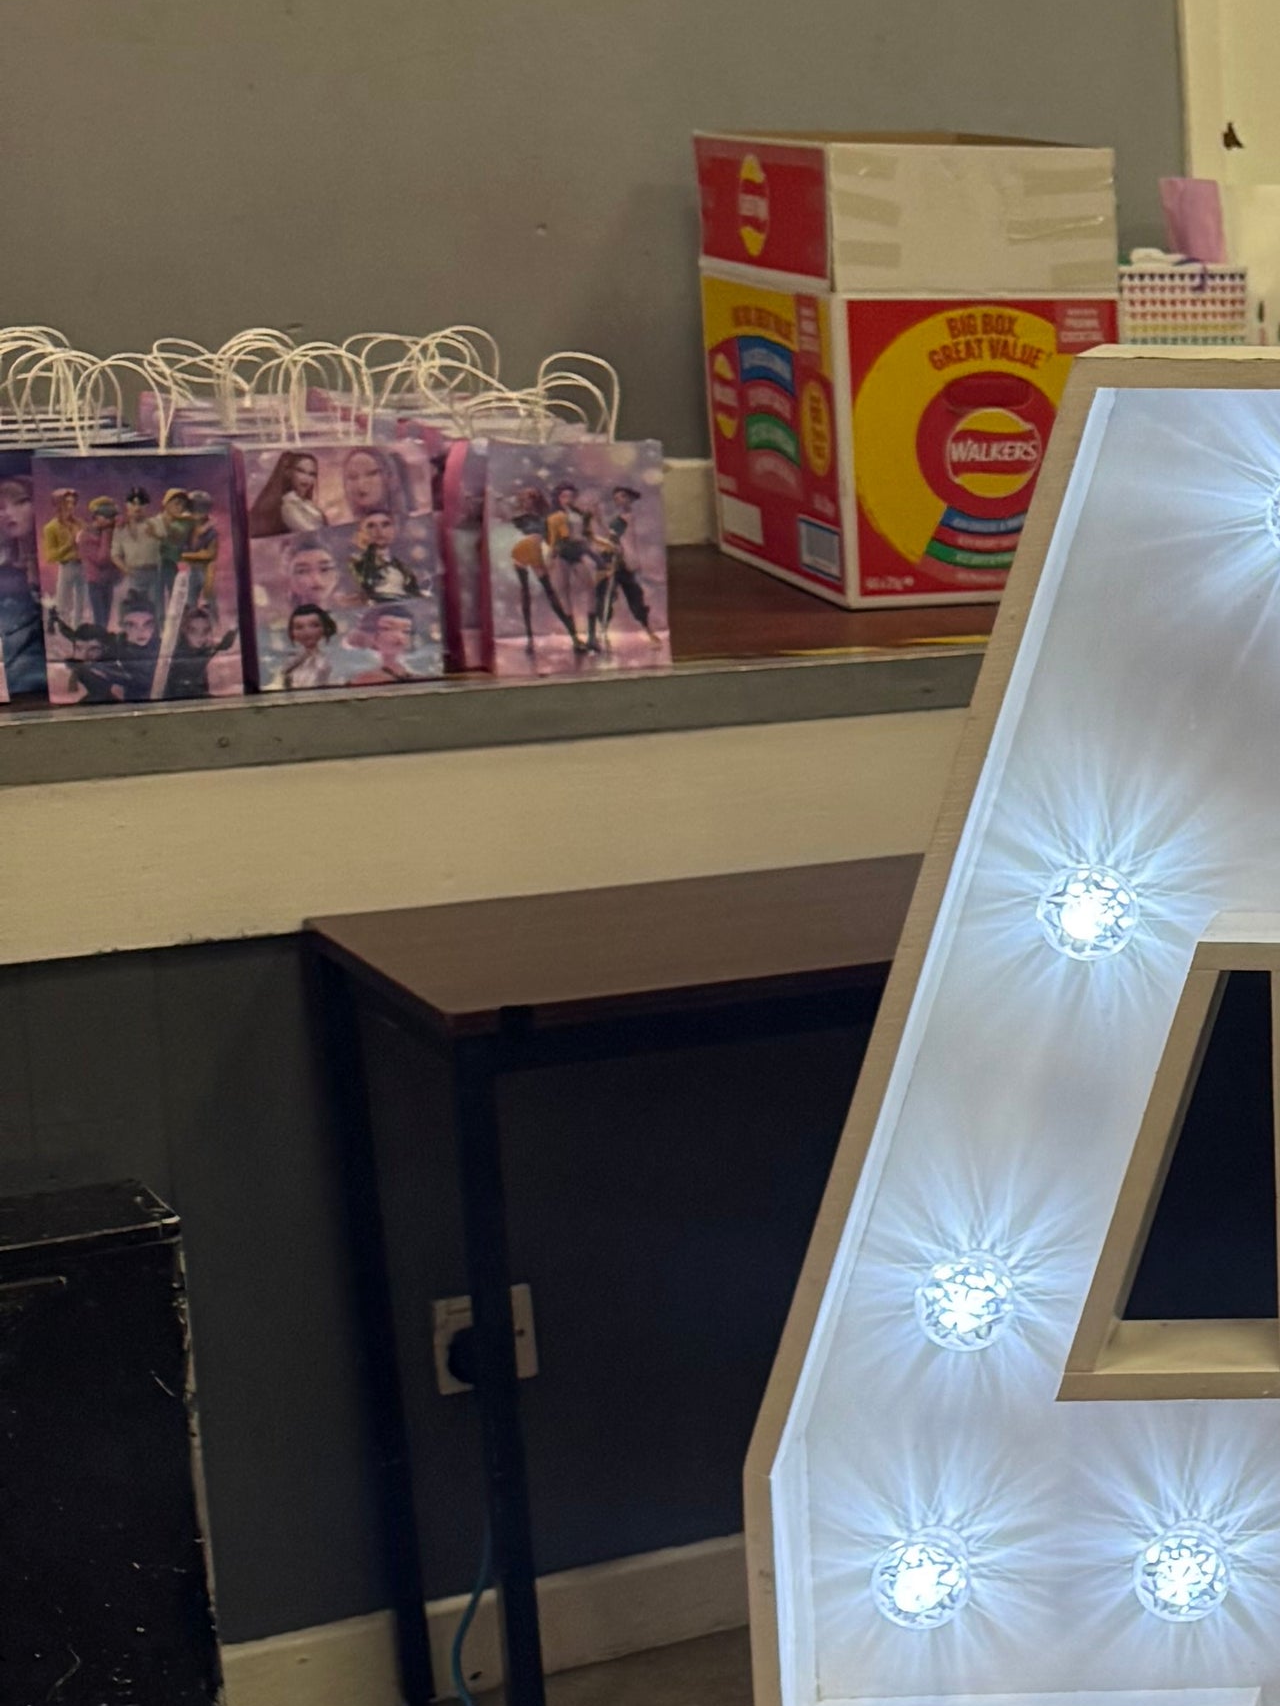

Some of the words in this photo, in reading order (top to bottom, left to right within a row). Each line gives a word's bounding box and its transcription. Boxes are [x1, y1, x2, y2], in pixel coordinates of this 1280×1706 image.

[946, 313, 978, 340] BIG
[982, 313, 1019, 339] BOX
[928, 337, 984, 371] GREAT
[951, 438, 1038, 462] WALKERS
